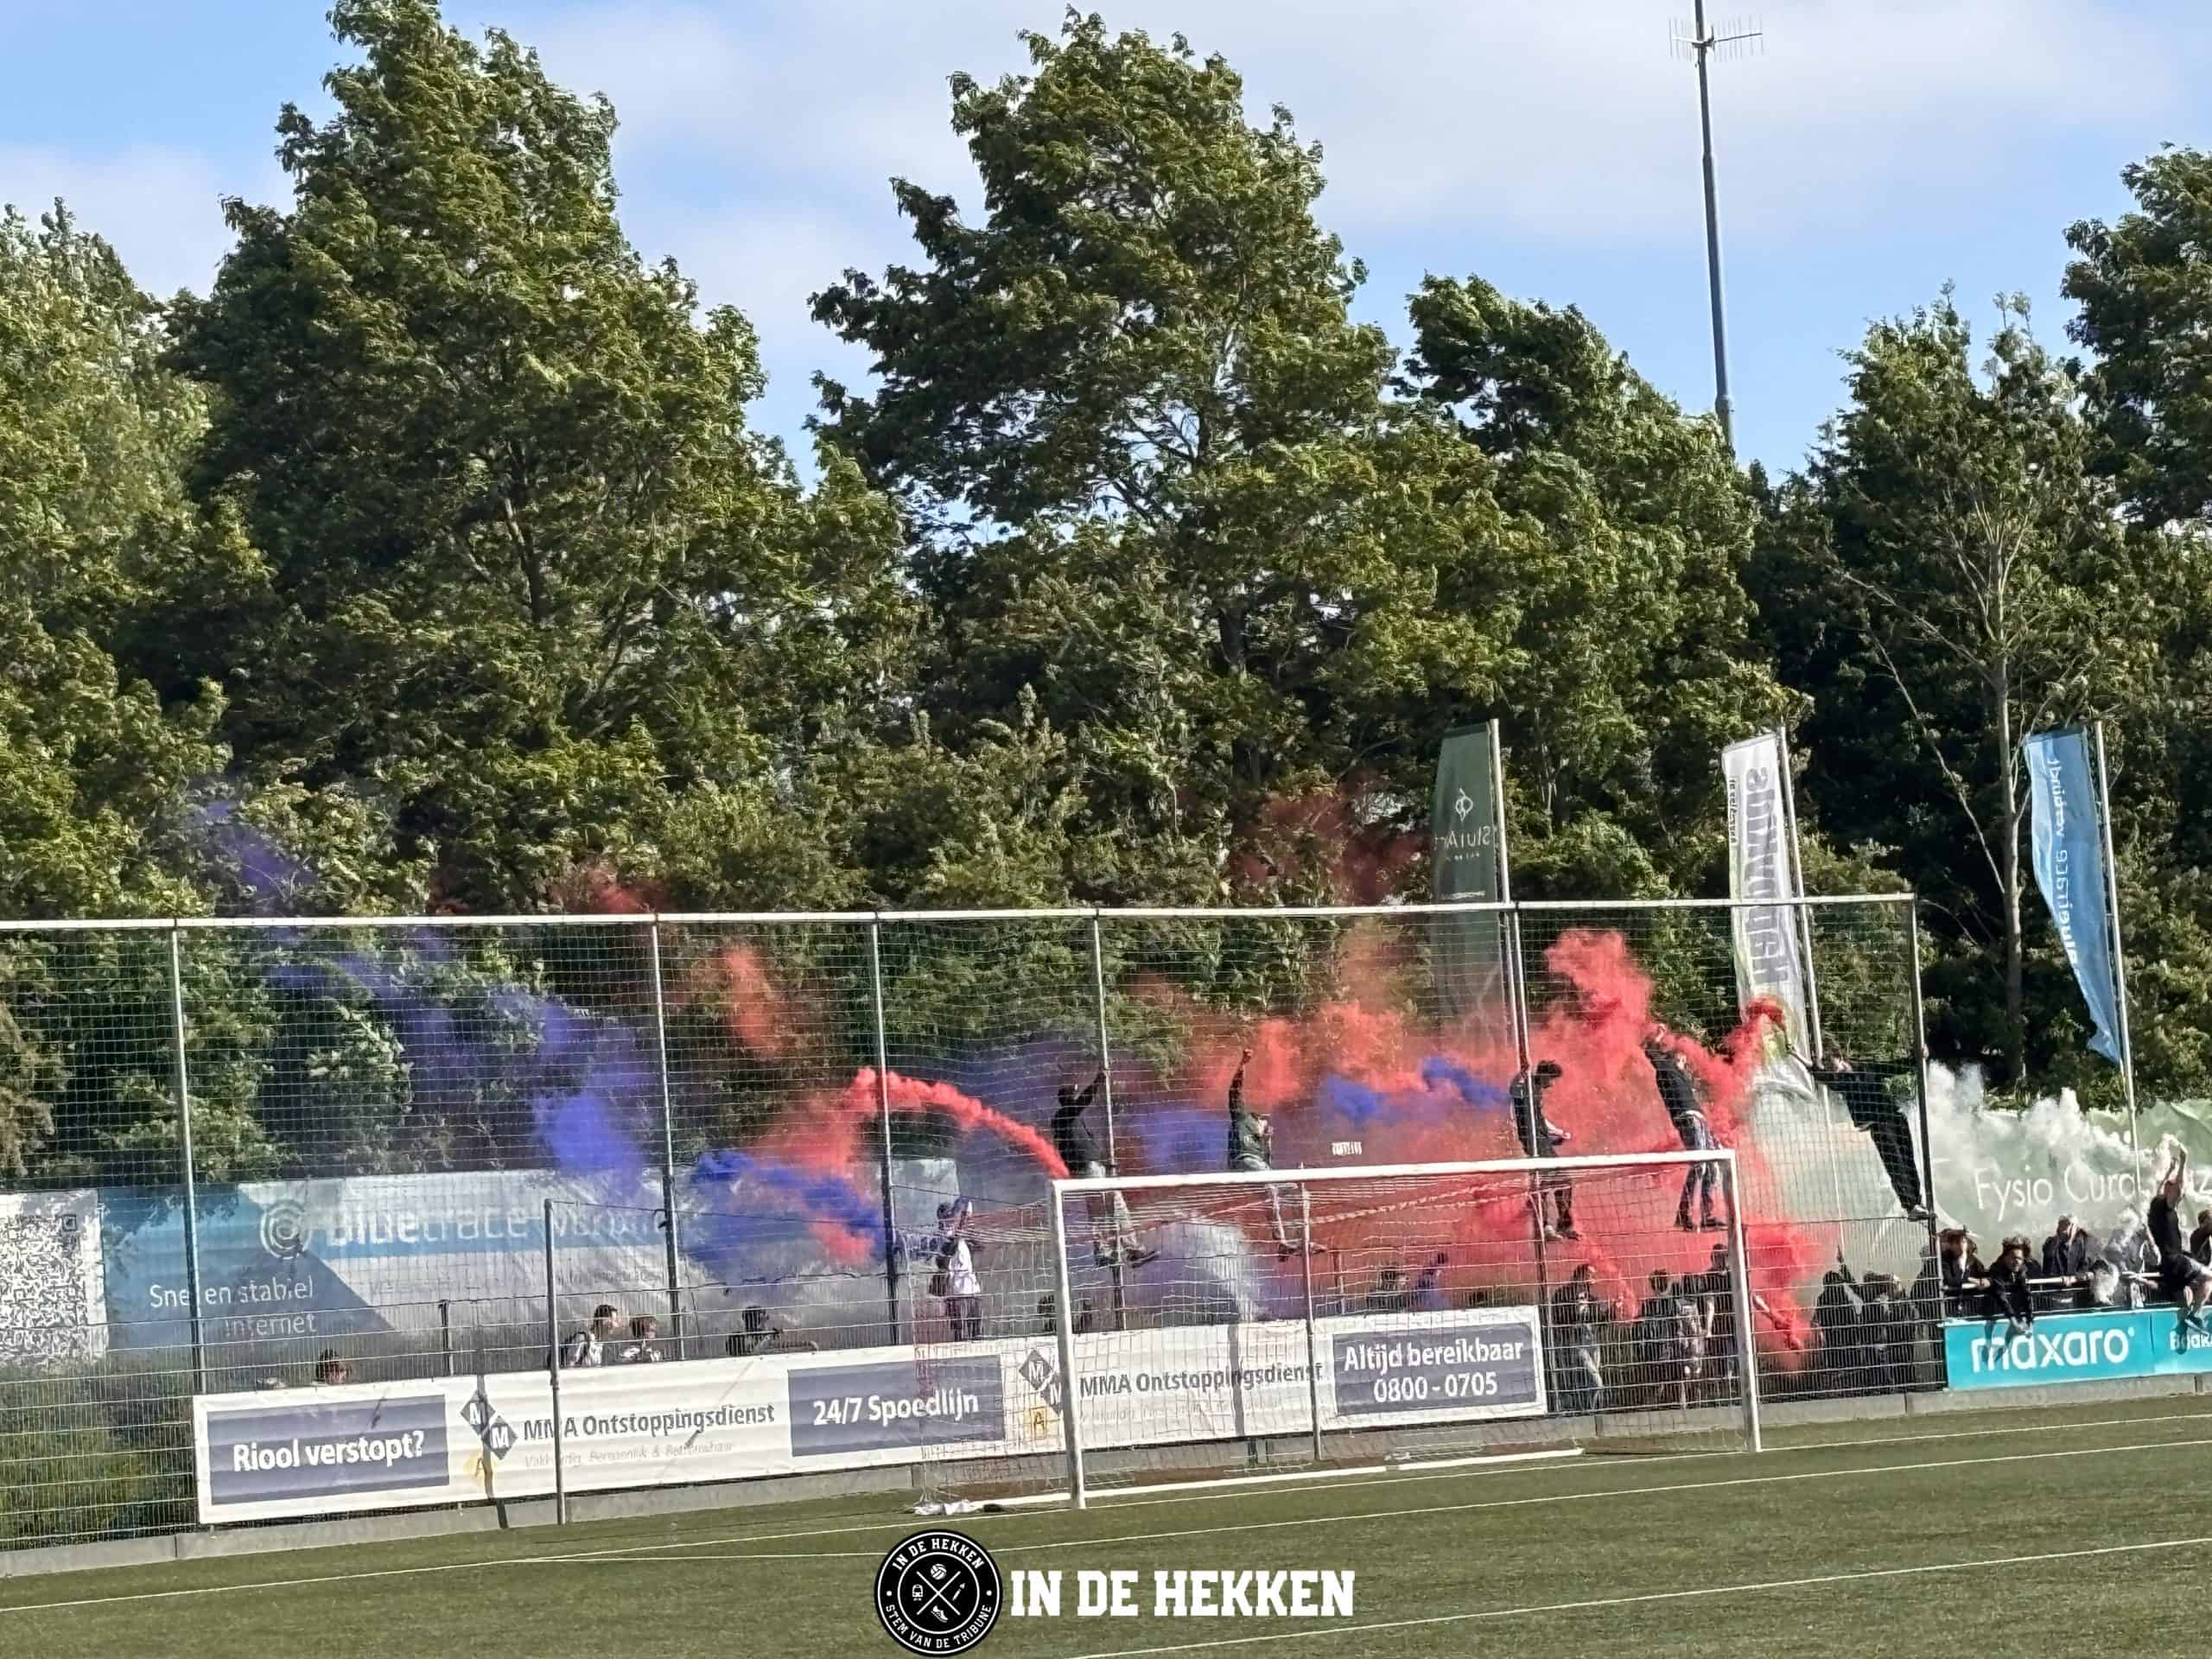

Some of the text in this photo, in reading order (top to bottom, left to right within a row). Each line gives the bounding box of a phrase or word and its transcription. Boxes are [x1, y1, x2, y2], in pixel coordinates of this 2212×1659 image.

[1975, 1164, 2054, 1222] Fysio
[149, 1283, 200, 1308] Sne
[205, 1287, 232, 1306] en
[1344, 1337, 1524, 1376] Altijd bereikbaar
[1373, 1376, 1428, 1403] 0800
[1444, 1371, 1498, 1397] 0705
[582, 1403, 775, 1438] Ontstoppingsdienst
[812, 1388, 979, 1427] 24/7 Spoedlijn
[232, 1430, 425, 1472] Riool verstopt?
